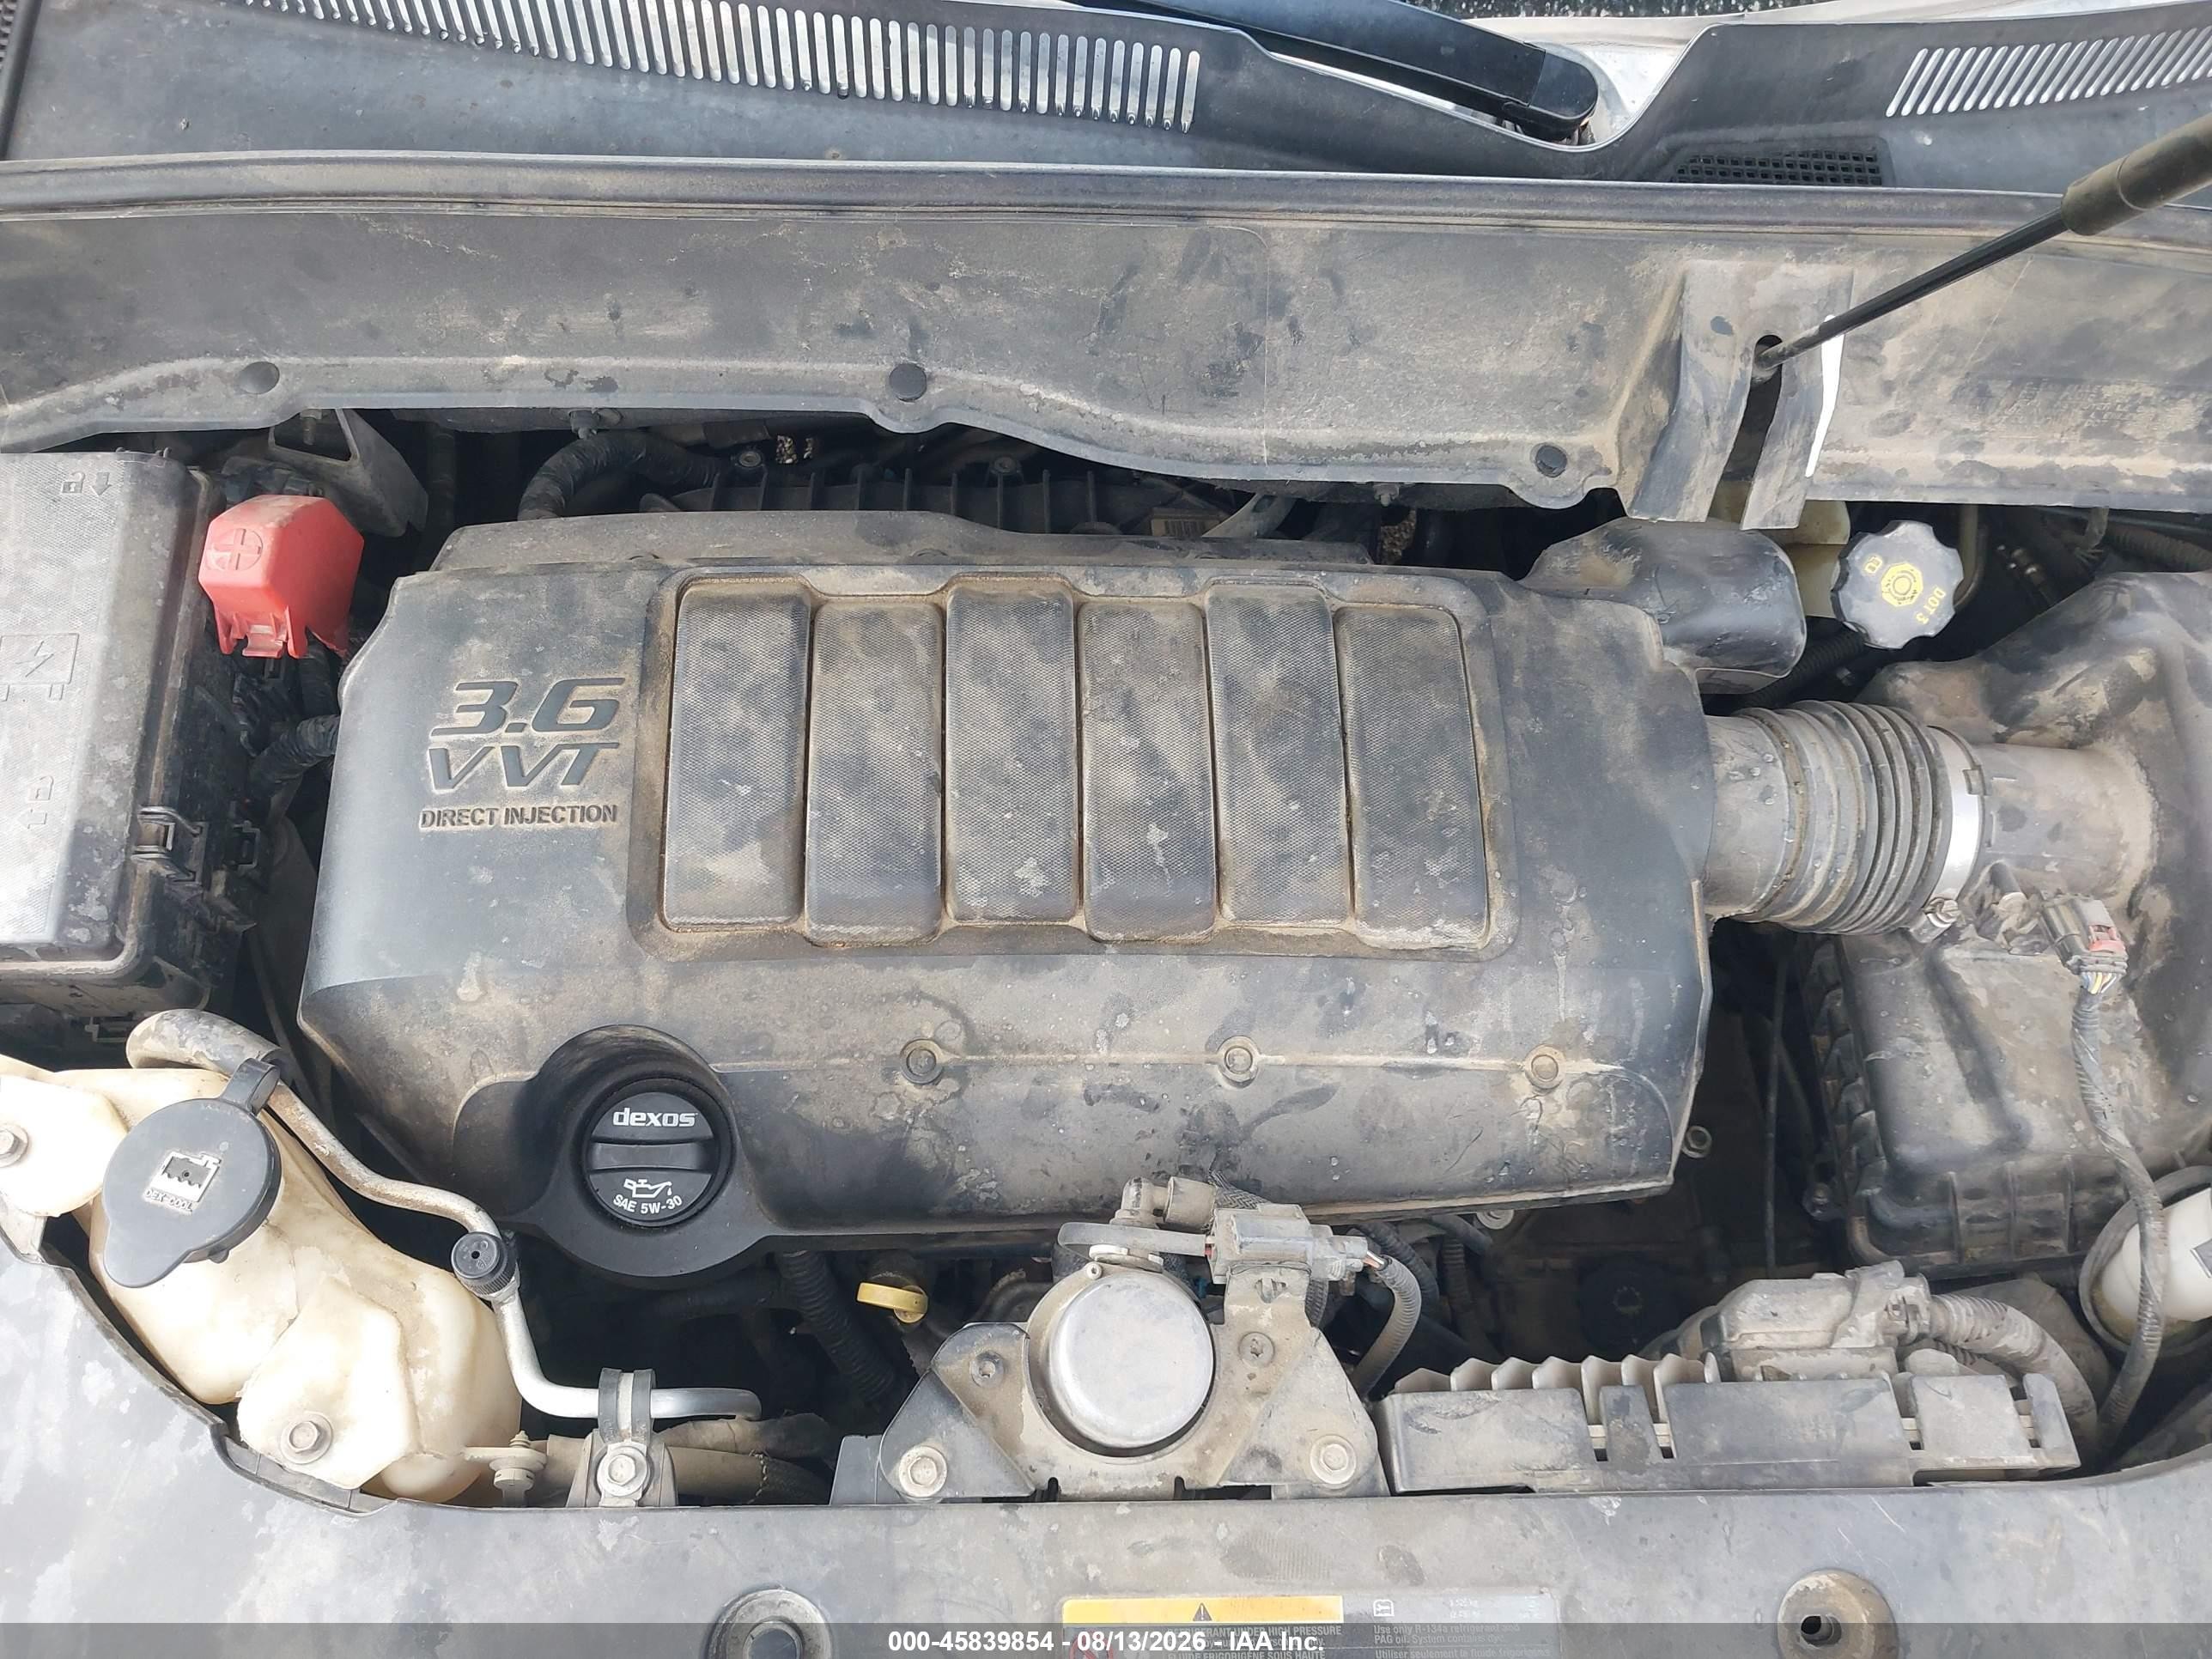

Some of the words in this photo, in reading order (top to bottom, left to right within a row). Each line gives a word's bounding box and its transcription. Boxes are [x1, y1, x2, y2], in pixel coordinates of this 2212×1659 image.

[1923, 586, 1946, 615] DOT
[1916, 612, 1929, 624] 3
[429, 677, 626, 737] 3.6
[428, 742, 620, 791] VVT
[420, 806, 498, 828] DIRECT
[504, 804, 618, 825] INJECTION
[612, 1107, 696, 1127] dexos
[613, 1194, 638, 1212] SAE
[640, 1194, 684, 1214] 5W-30
[1293, 1625, 1342, 1636] PRESSURE
[1374, 1625, 1391, 1634] Use
[1393, 1626, 1413, 1635] only
[1374, 1634, 1393, 1644] PAG
